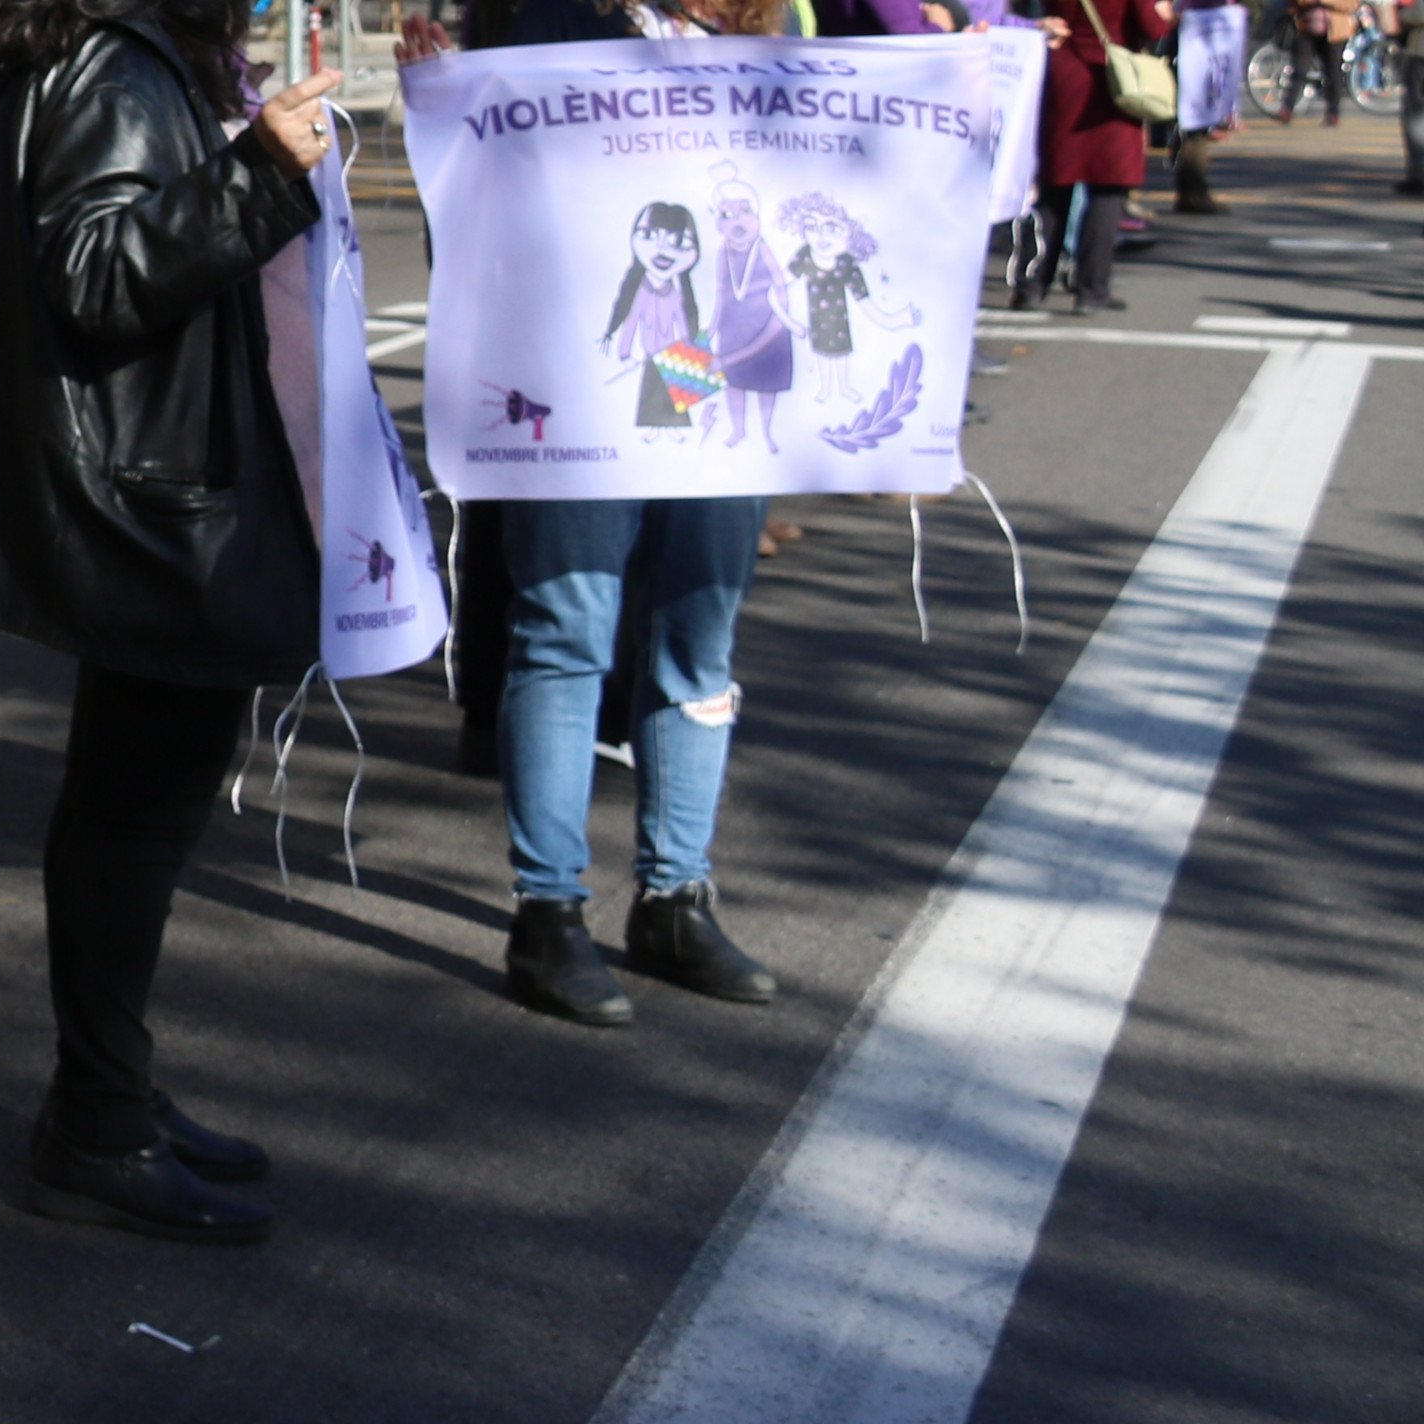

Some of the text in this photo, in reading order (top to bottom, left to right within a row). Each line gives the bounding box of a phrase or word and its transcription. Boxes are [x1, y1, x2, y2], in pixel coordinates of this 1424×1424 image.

[464, 85, 976, 148] VIOLÈNCIES MASCLISTES,
[601, 126, 867, 157] JUSTÍCIA FEMINISTA
[465, 445, 619, 463] NOVEMBRE FEMINISTA
